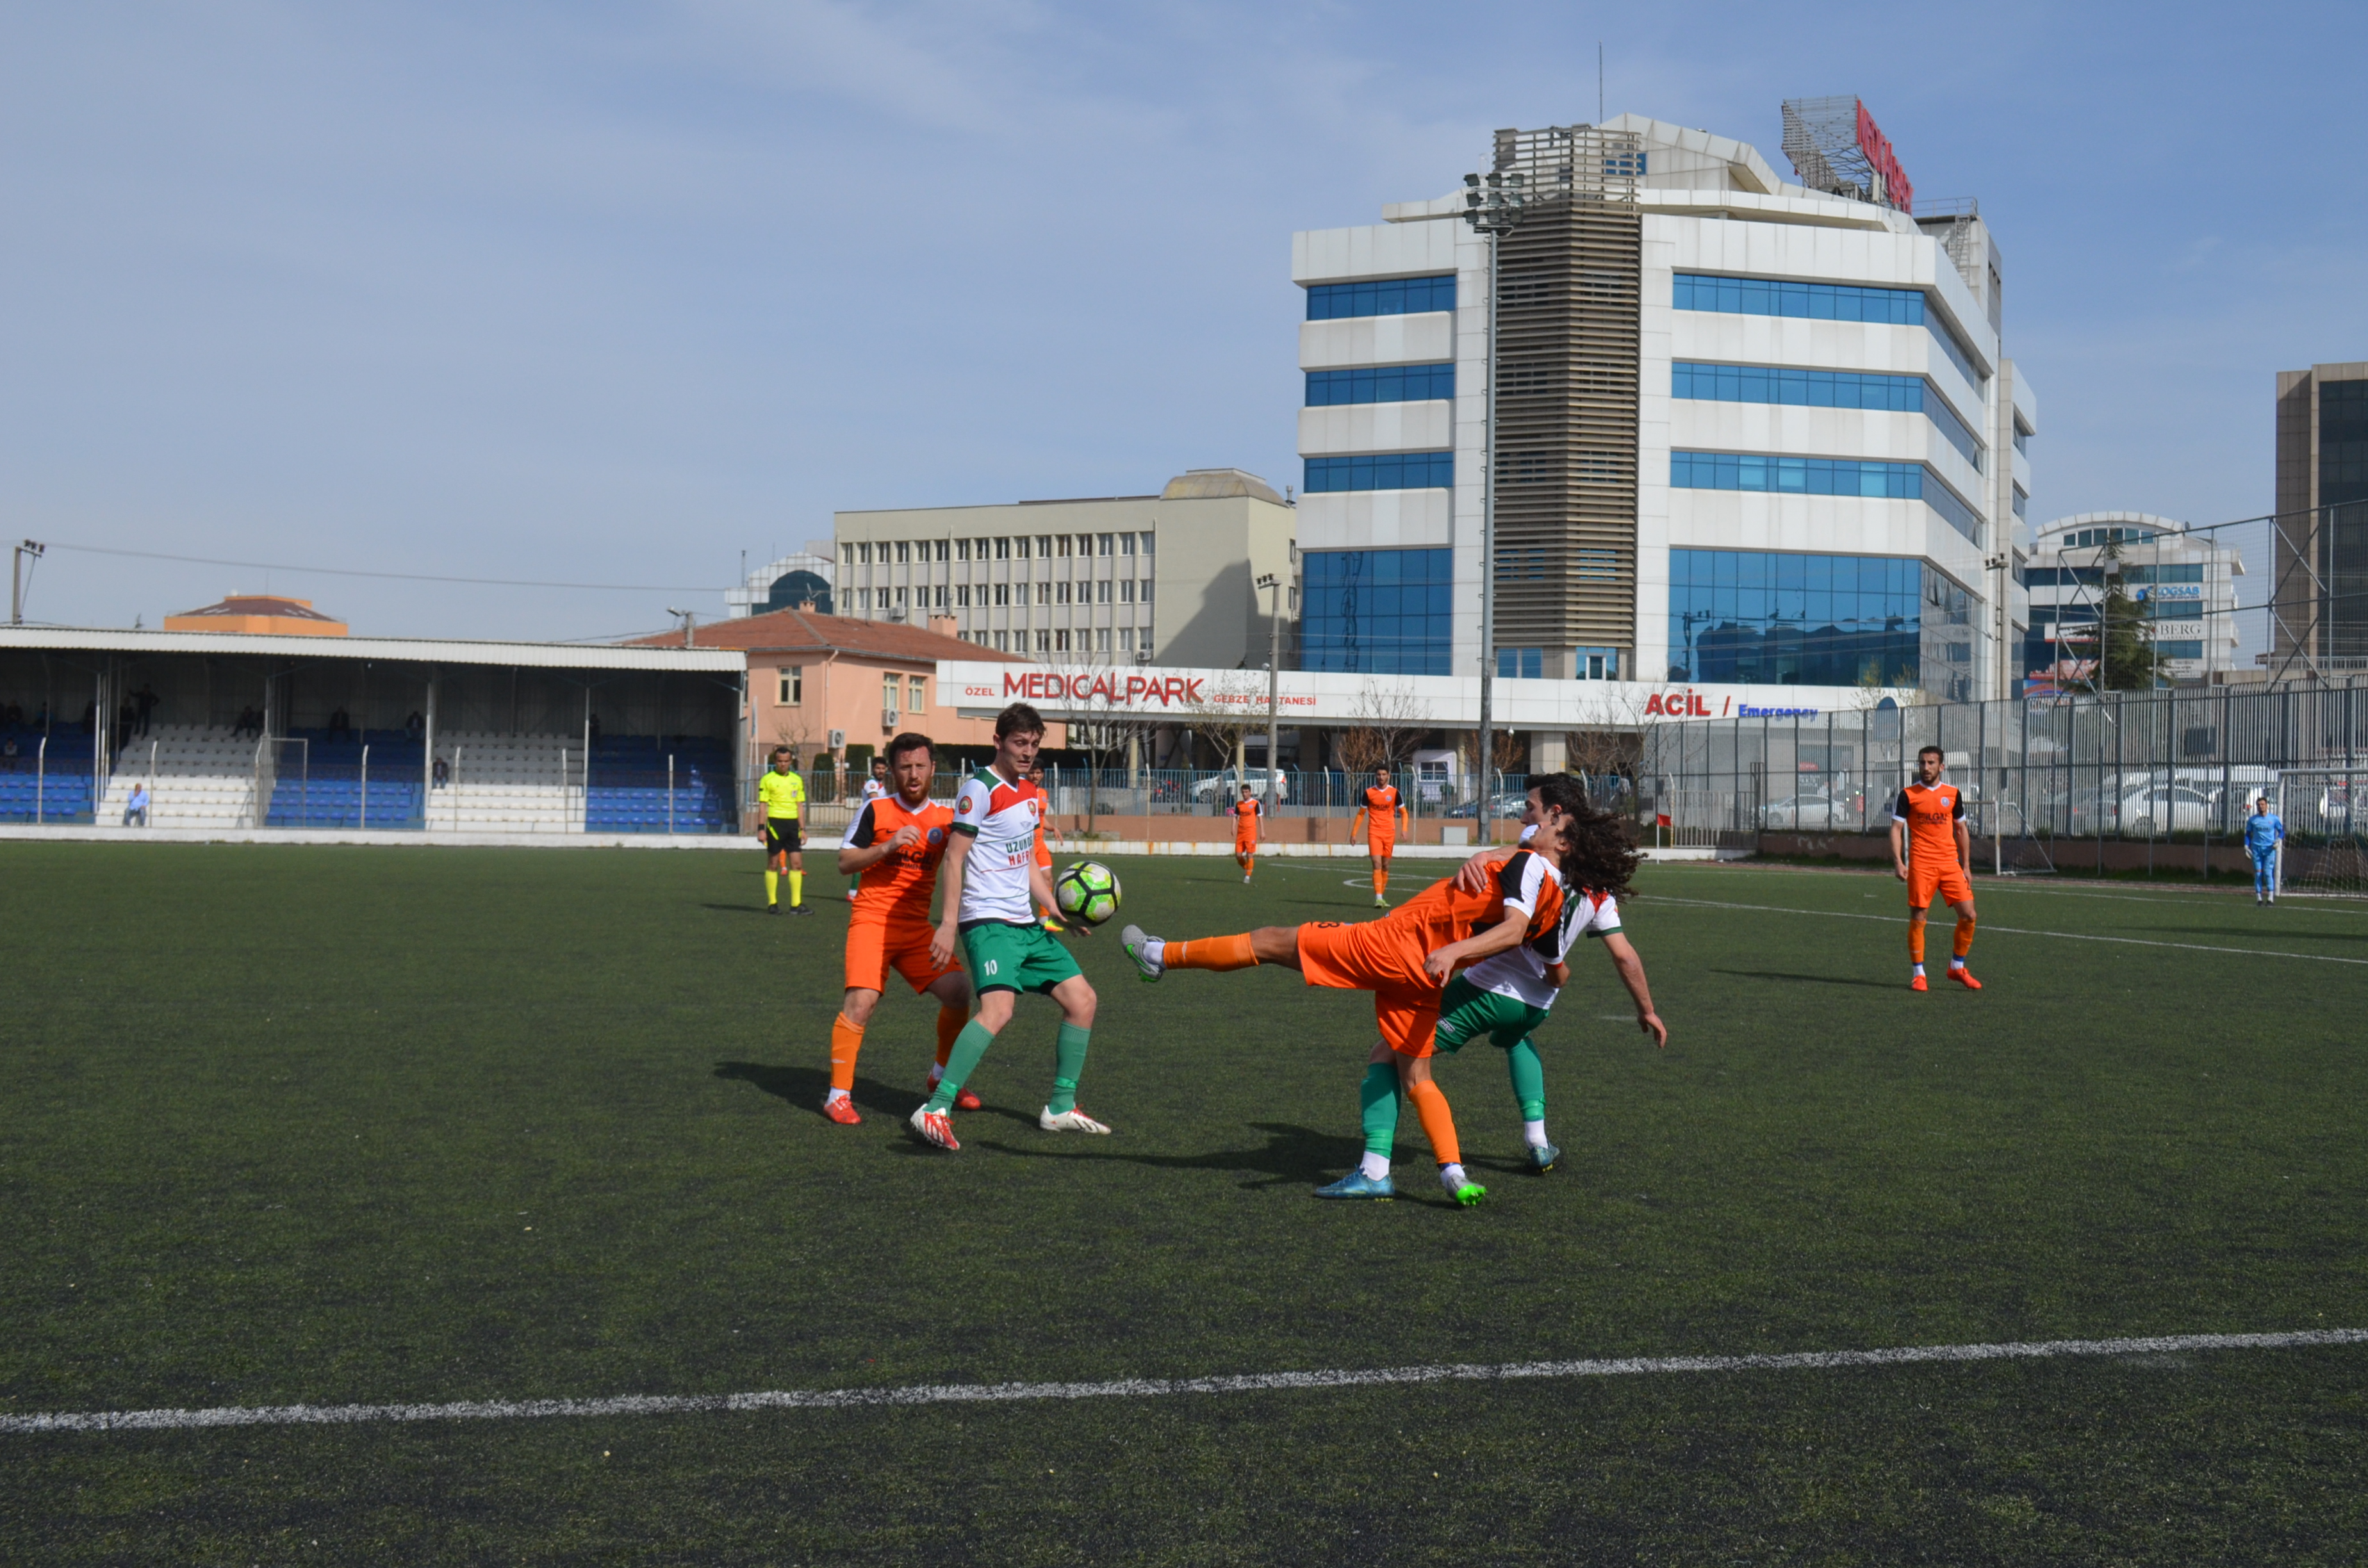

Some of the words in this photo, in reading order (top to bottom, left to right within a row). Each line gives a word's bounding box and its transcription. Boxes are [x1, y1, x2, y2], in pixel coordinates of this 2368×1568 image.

[2160, 624, 2201, 635] BERG
[965, 685, 995, 696] ÖZEL
[1213, 695, 1249, 704] GEBZE
[1256, 695, 1317, 705] HATANESİ
[1644, 688, 1711, 716] ACİL
[1008, 851, 1030, 866] HAFR
[983, 960, 998, 976] 10
